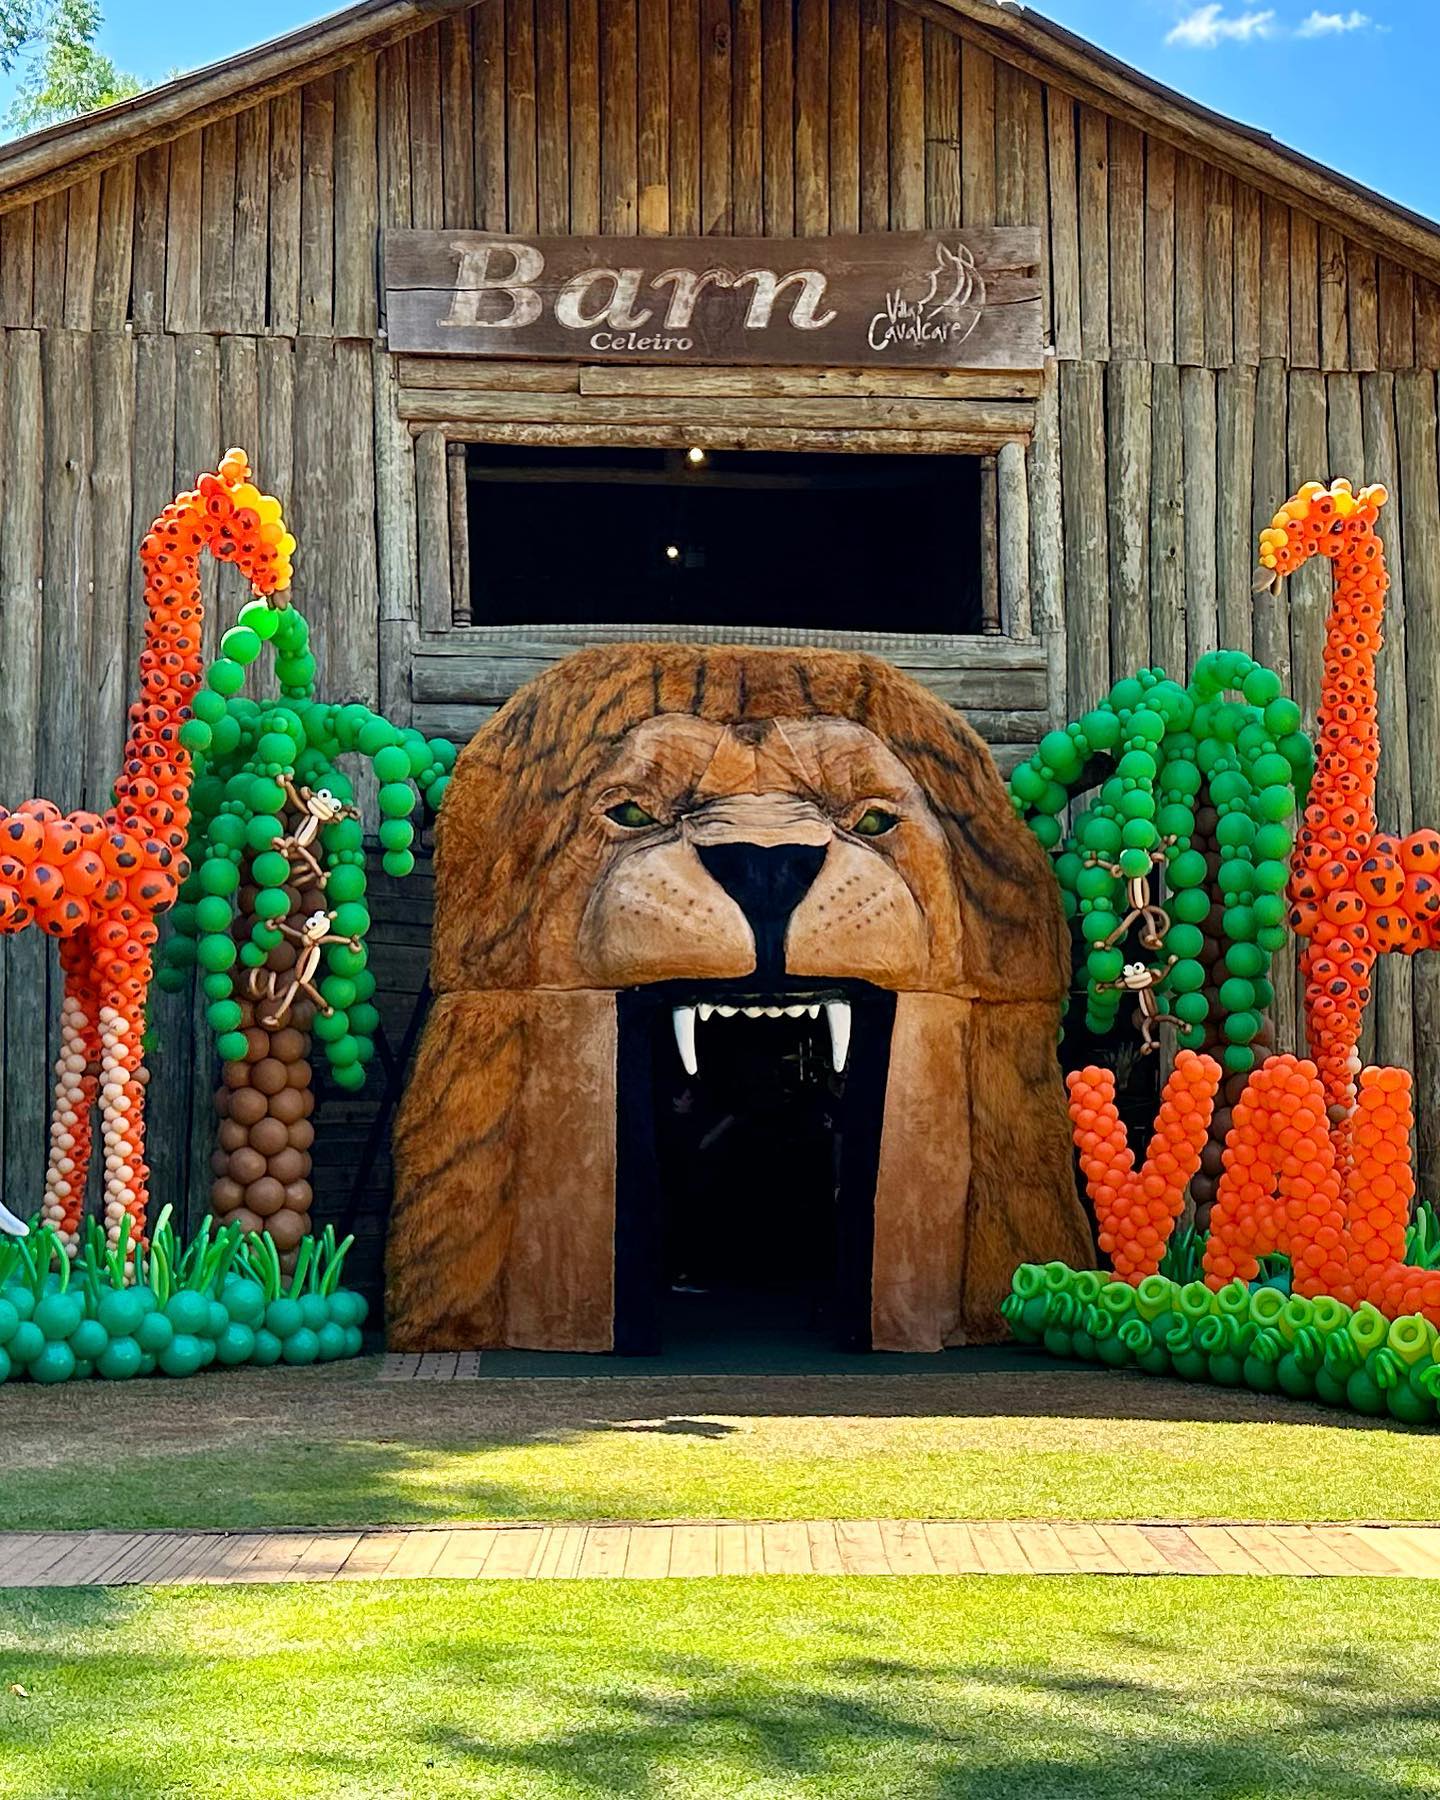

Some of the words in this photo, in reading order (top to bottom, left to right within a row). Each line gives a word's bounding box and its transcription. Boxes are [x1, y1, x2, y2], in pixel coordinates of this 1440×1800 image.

[438, 242, 837, 331] Barn
[590, 332, 694, 350] Celeiro
[868, 313, 961, 350] Cavalcare
